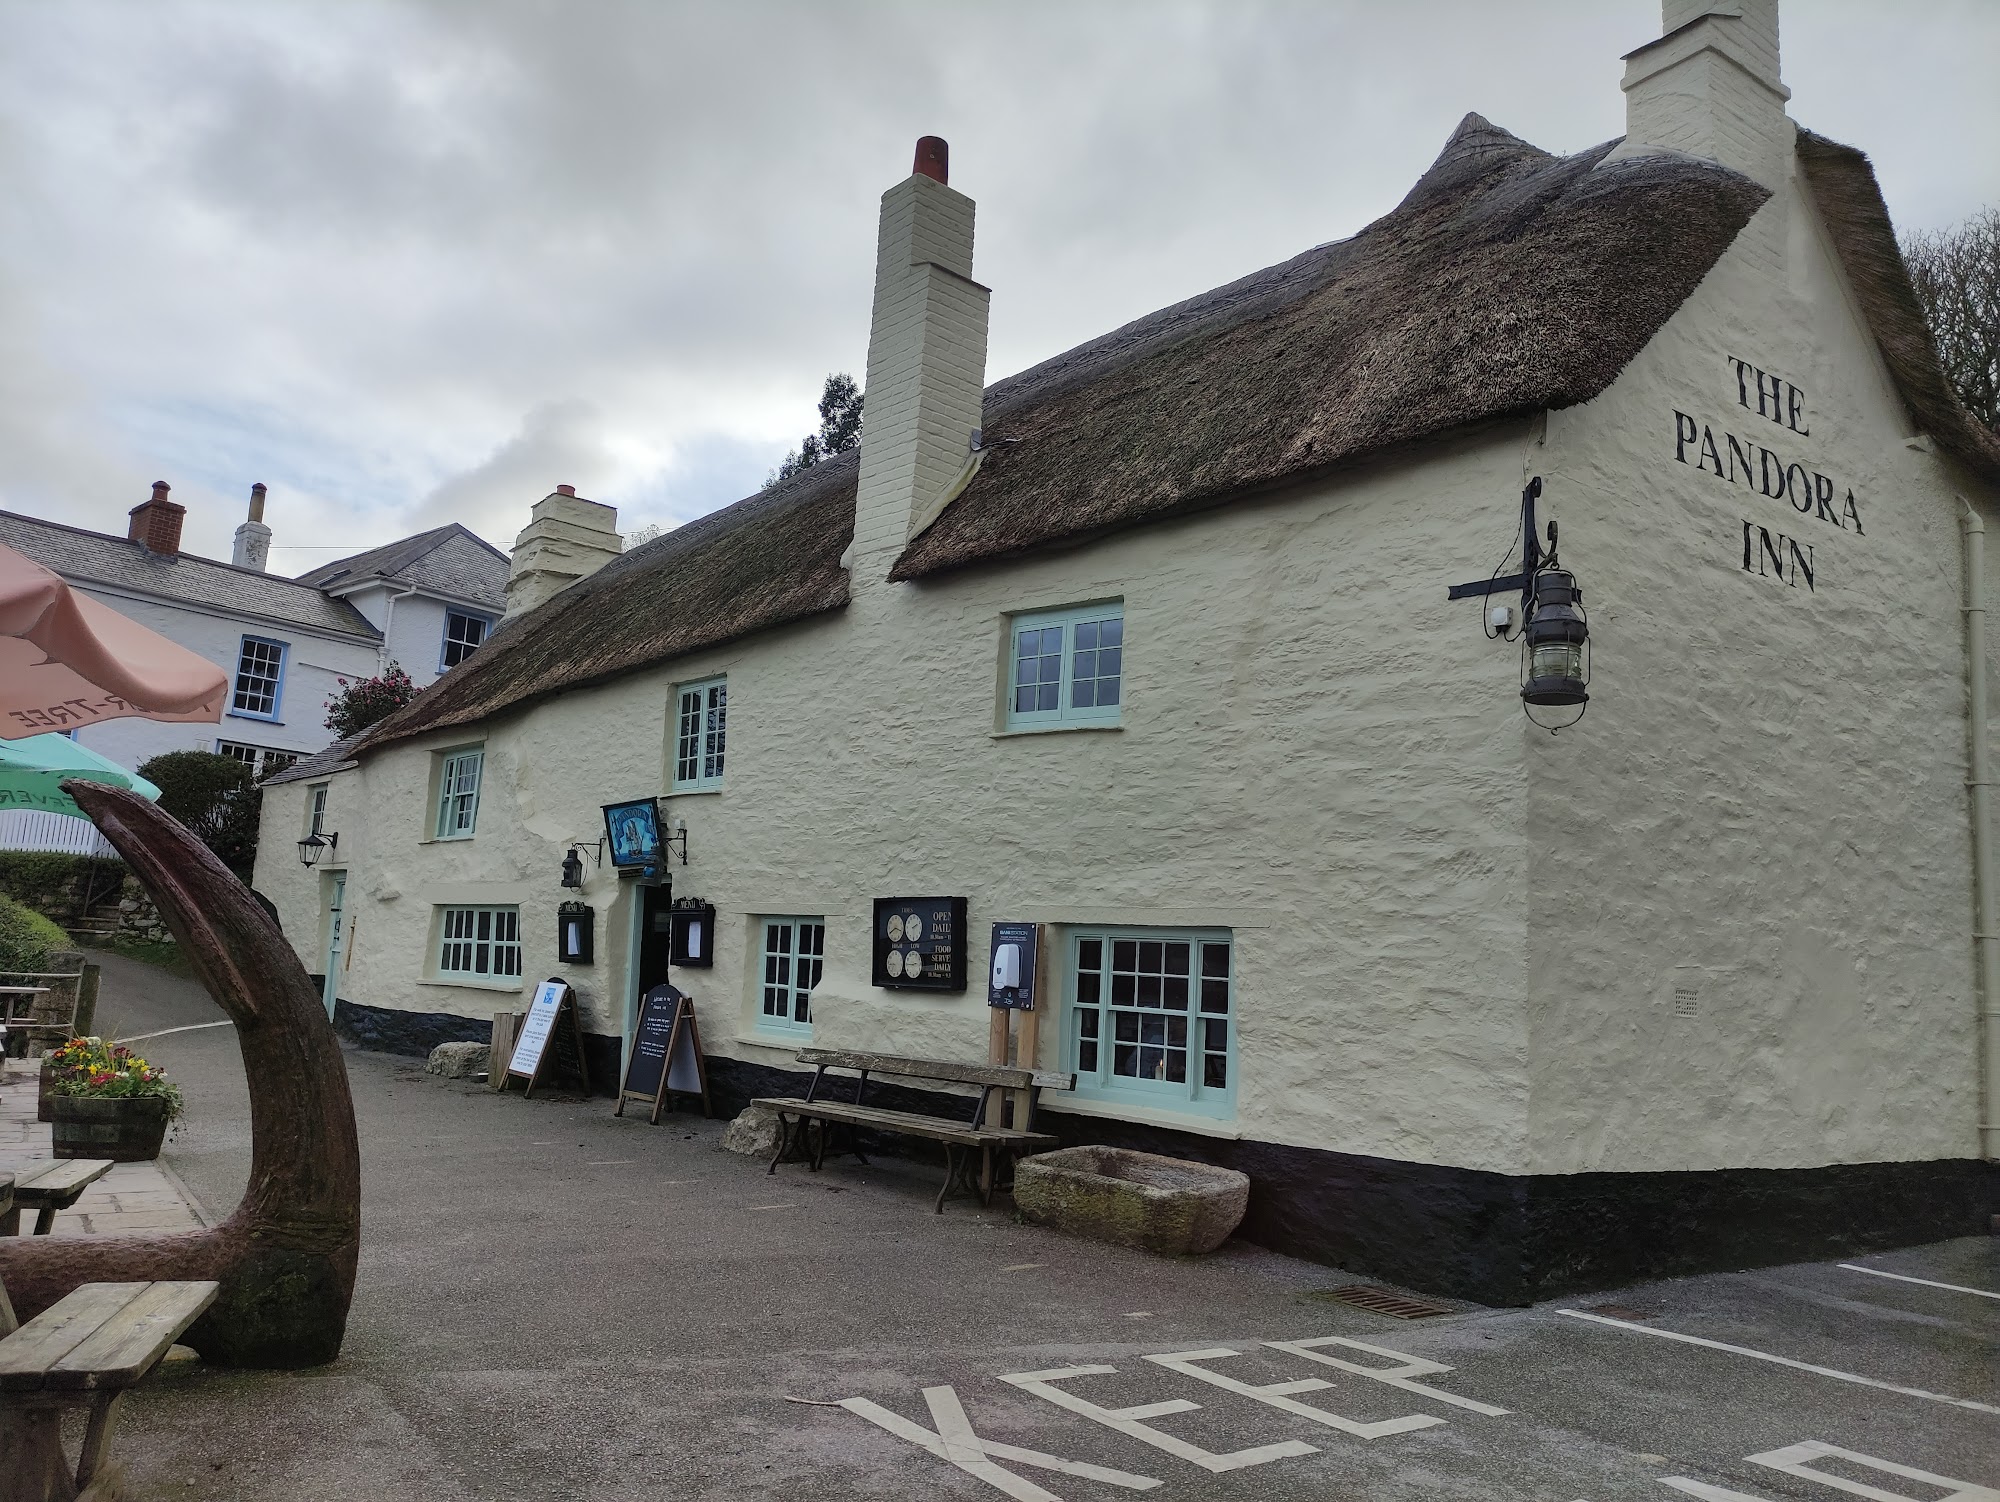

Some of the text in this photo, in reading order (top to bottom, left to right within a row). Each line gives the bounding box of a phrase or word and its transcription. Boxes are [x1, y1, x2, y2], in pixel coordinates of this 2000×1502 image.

[1727, 355, 1809, 437] THE
[1672, 408, 1866, 537] PANDORA
[1741, 519, 1815, 594] INN
[565, 904, 578, 912] MENU
[680, 900, 696, 909] MENU
[935, 945, 952, 953] FOOD
[840, 1336, 1513, 1502] KEEP
